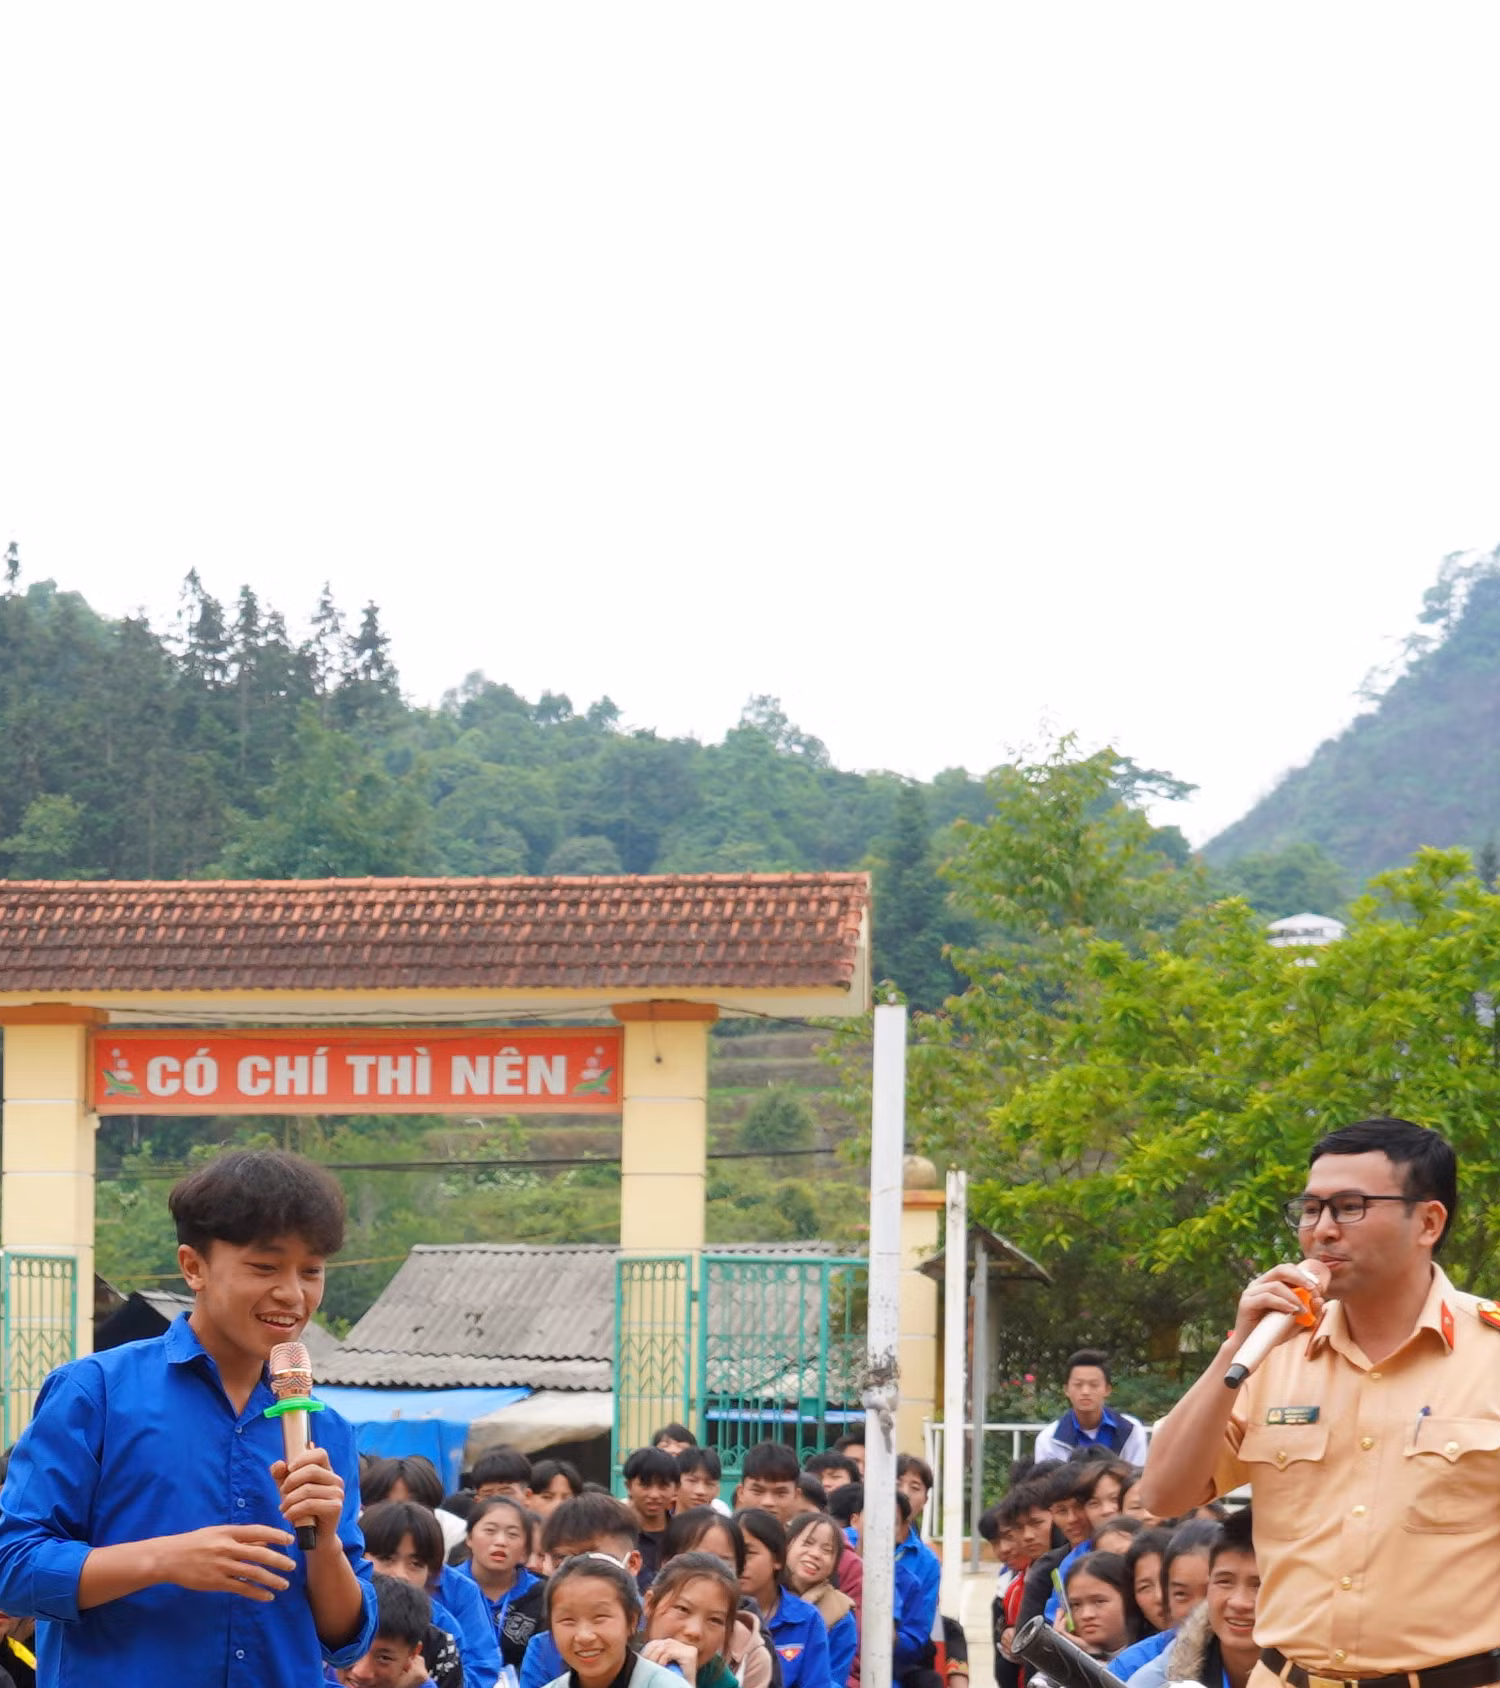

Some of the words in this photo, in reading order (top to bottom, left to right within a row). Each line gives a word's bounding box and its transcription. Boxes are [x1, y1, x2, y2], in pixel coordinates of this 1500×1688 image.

[146, 1047, 218, 1096] CÓ
[236, 1046, 330, 1096] CHÍ
[345, 1046, 432, 1096] THÌ
[450, 1046, 567, 1096] NÊN
